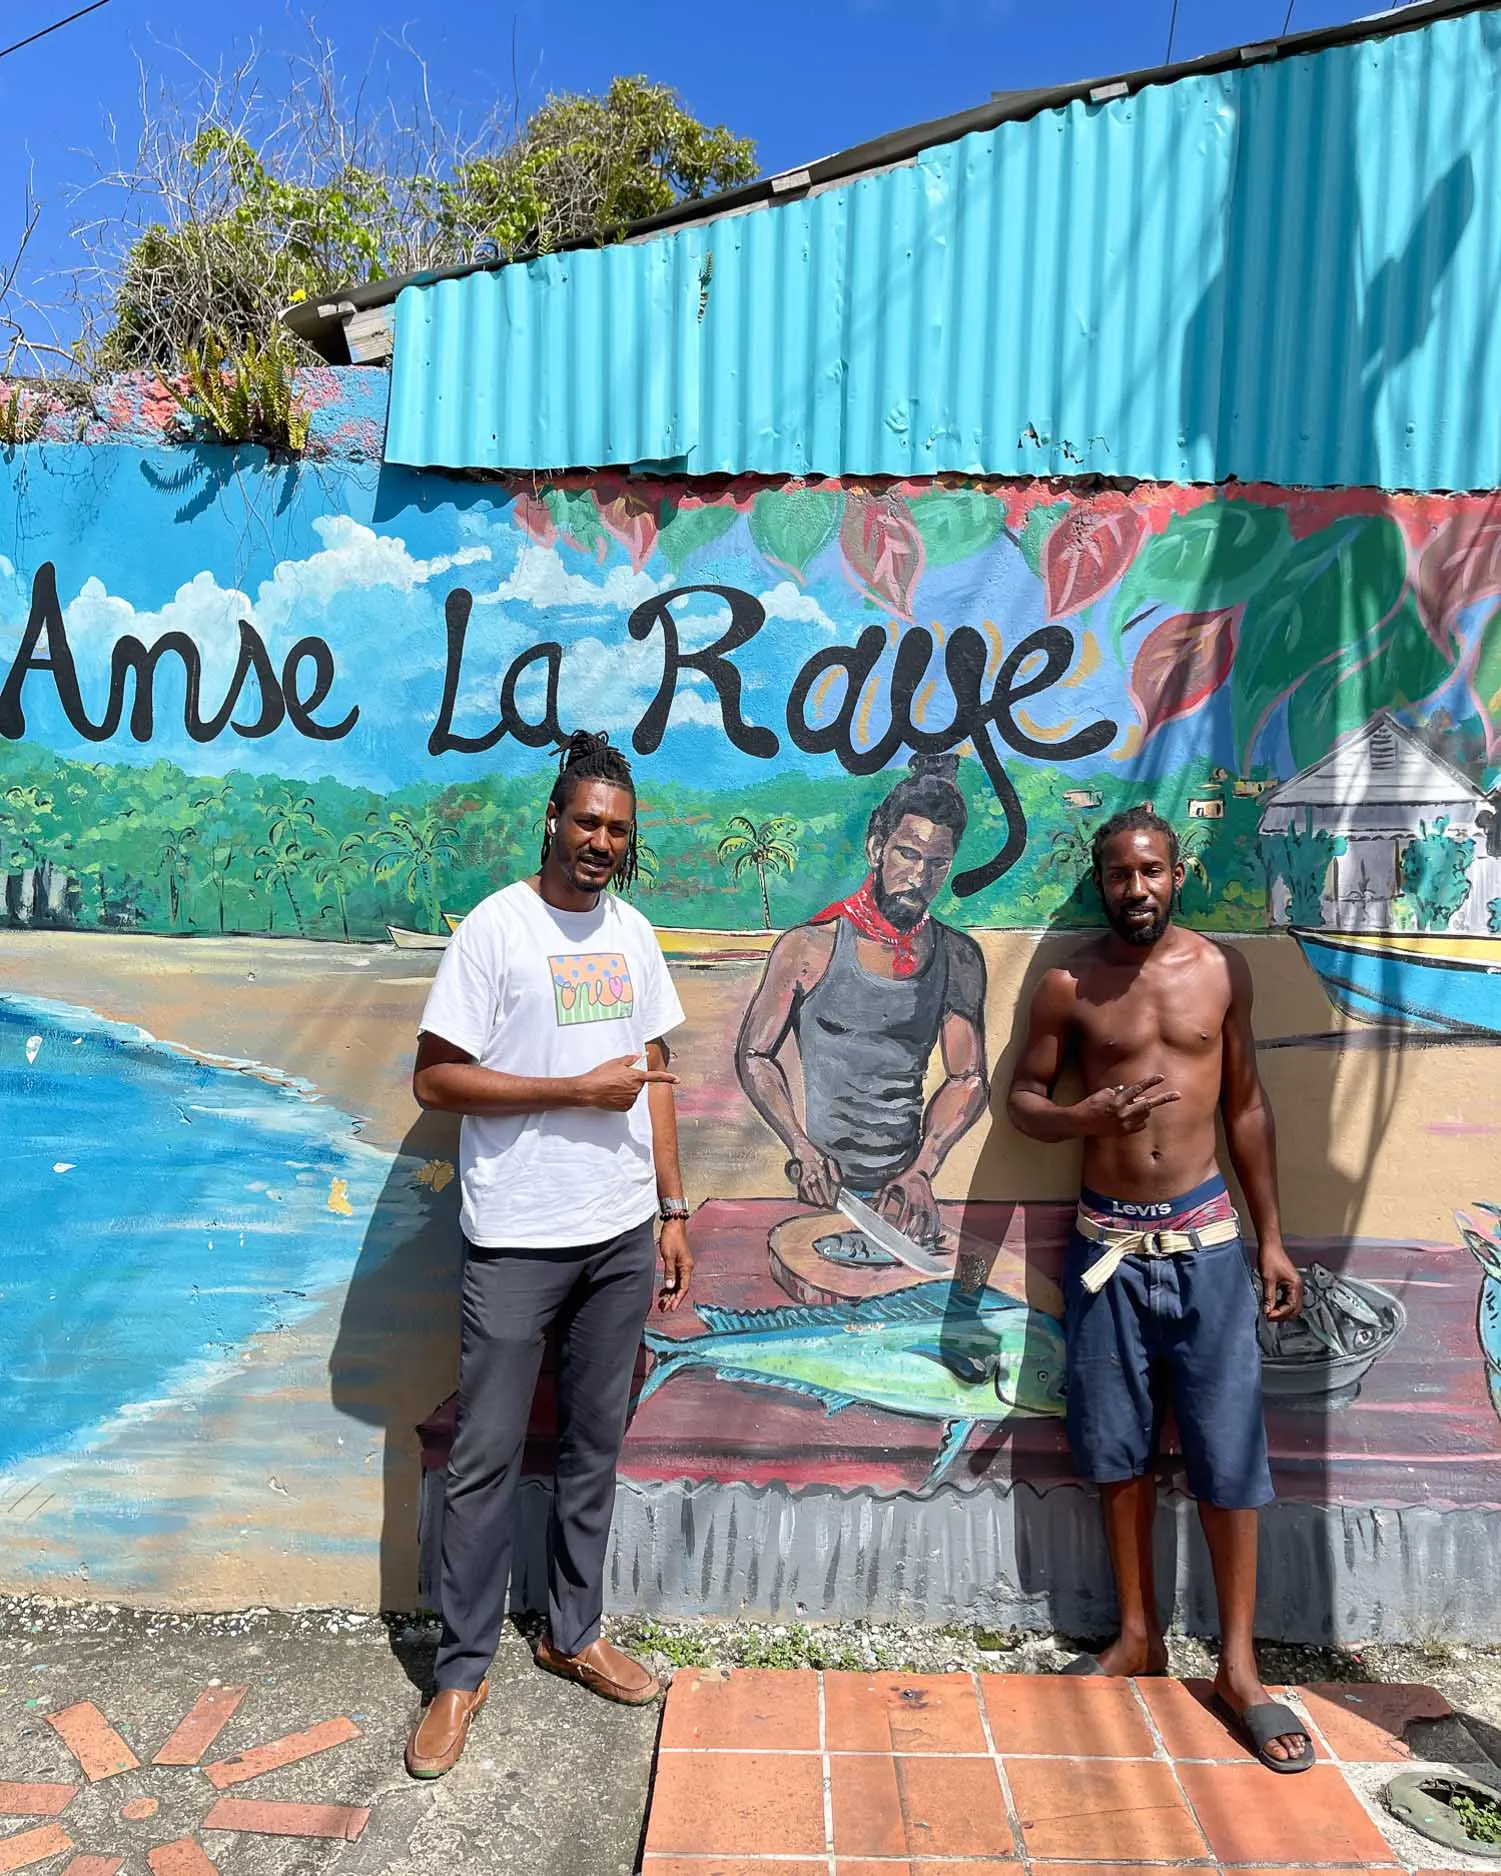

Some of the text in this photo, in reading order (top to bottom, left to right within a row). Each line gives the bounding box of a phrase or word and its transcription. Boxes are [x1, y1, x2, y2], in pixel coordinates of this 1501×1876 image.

[0, 561, 1118, 898] Anse La Raye
[1112, 1200, 1172, 1217] Levi's
